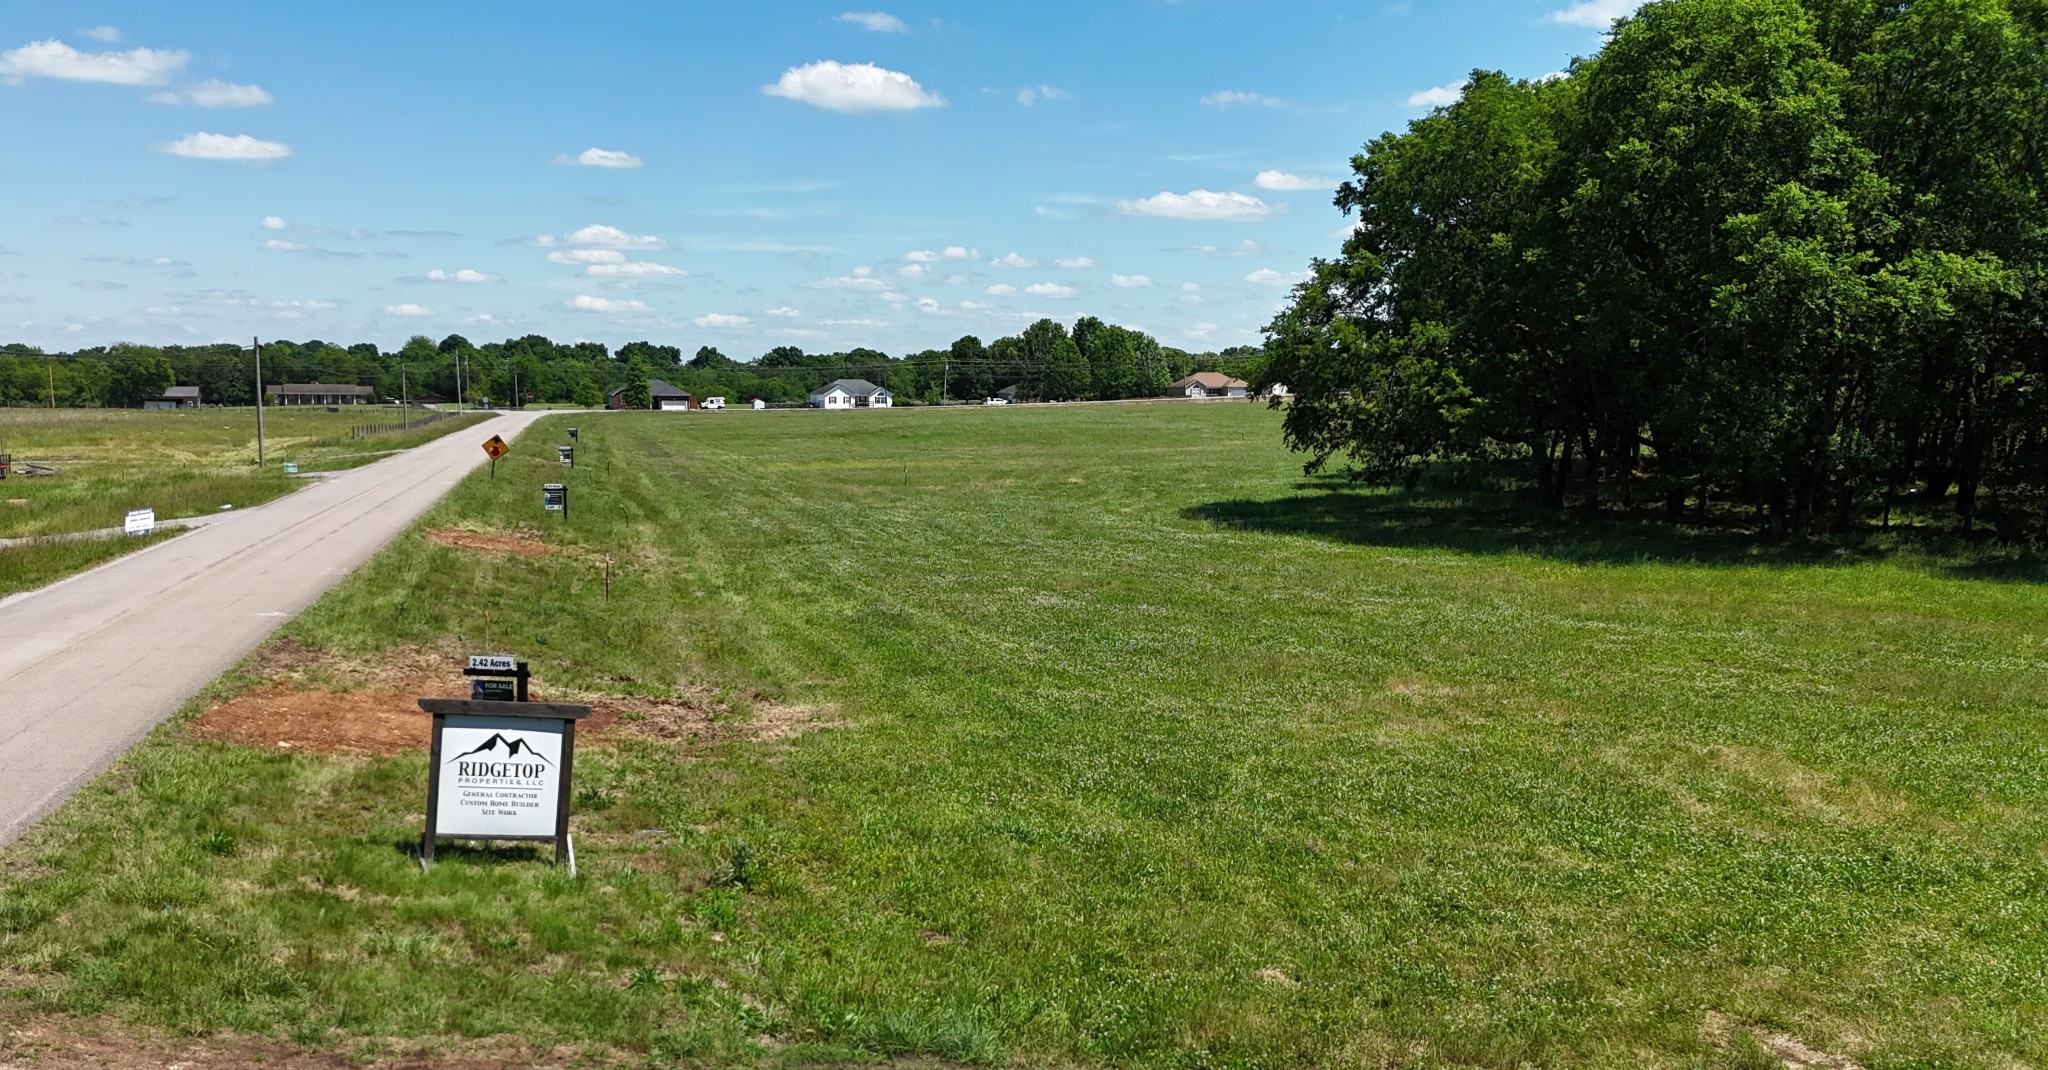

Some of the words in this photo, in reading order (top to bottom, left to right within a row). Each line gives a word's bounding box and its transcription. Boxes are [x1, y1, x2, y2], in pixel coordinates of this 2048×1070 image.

[472, 658, 488, 667] 2.42
[490, 659, 511, 668] Acres
[458, 761, 545, 778] RIDGETOP
